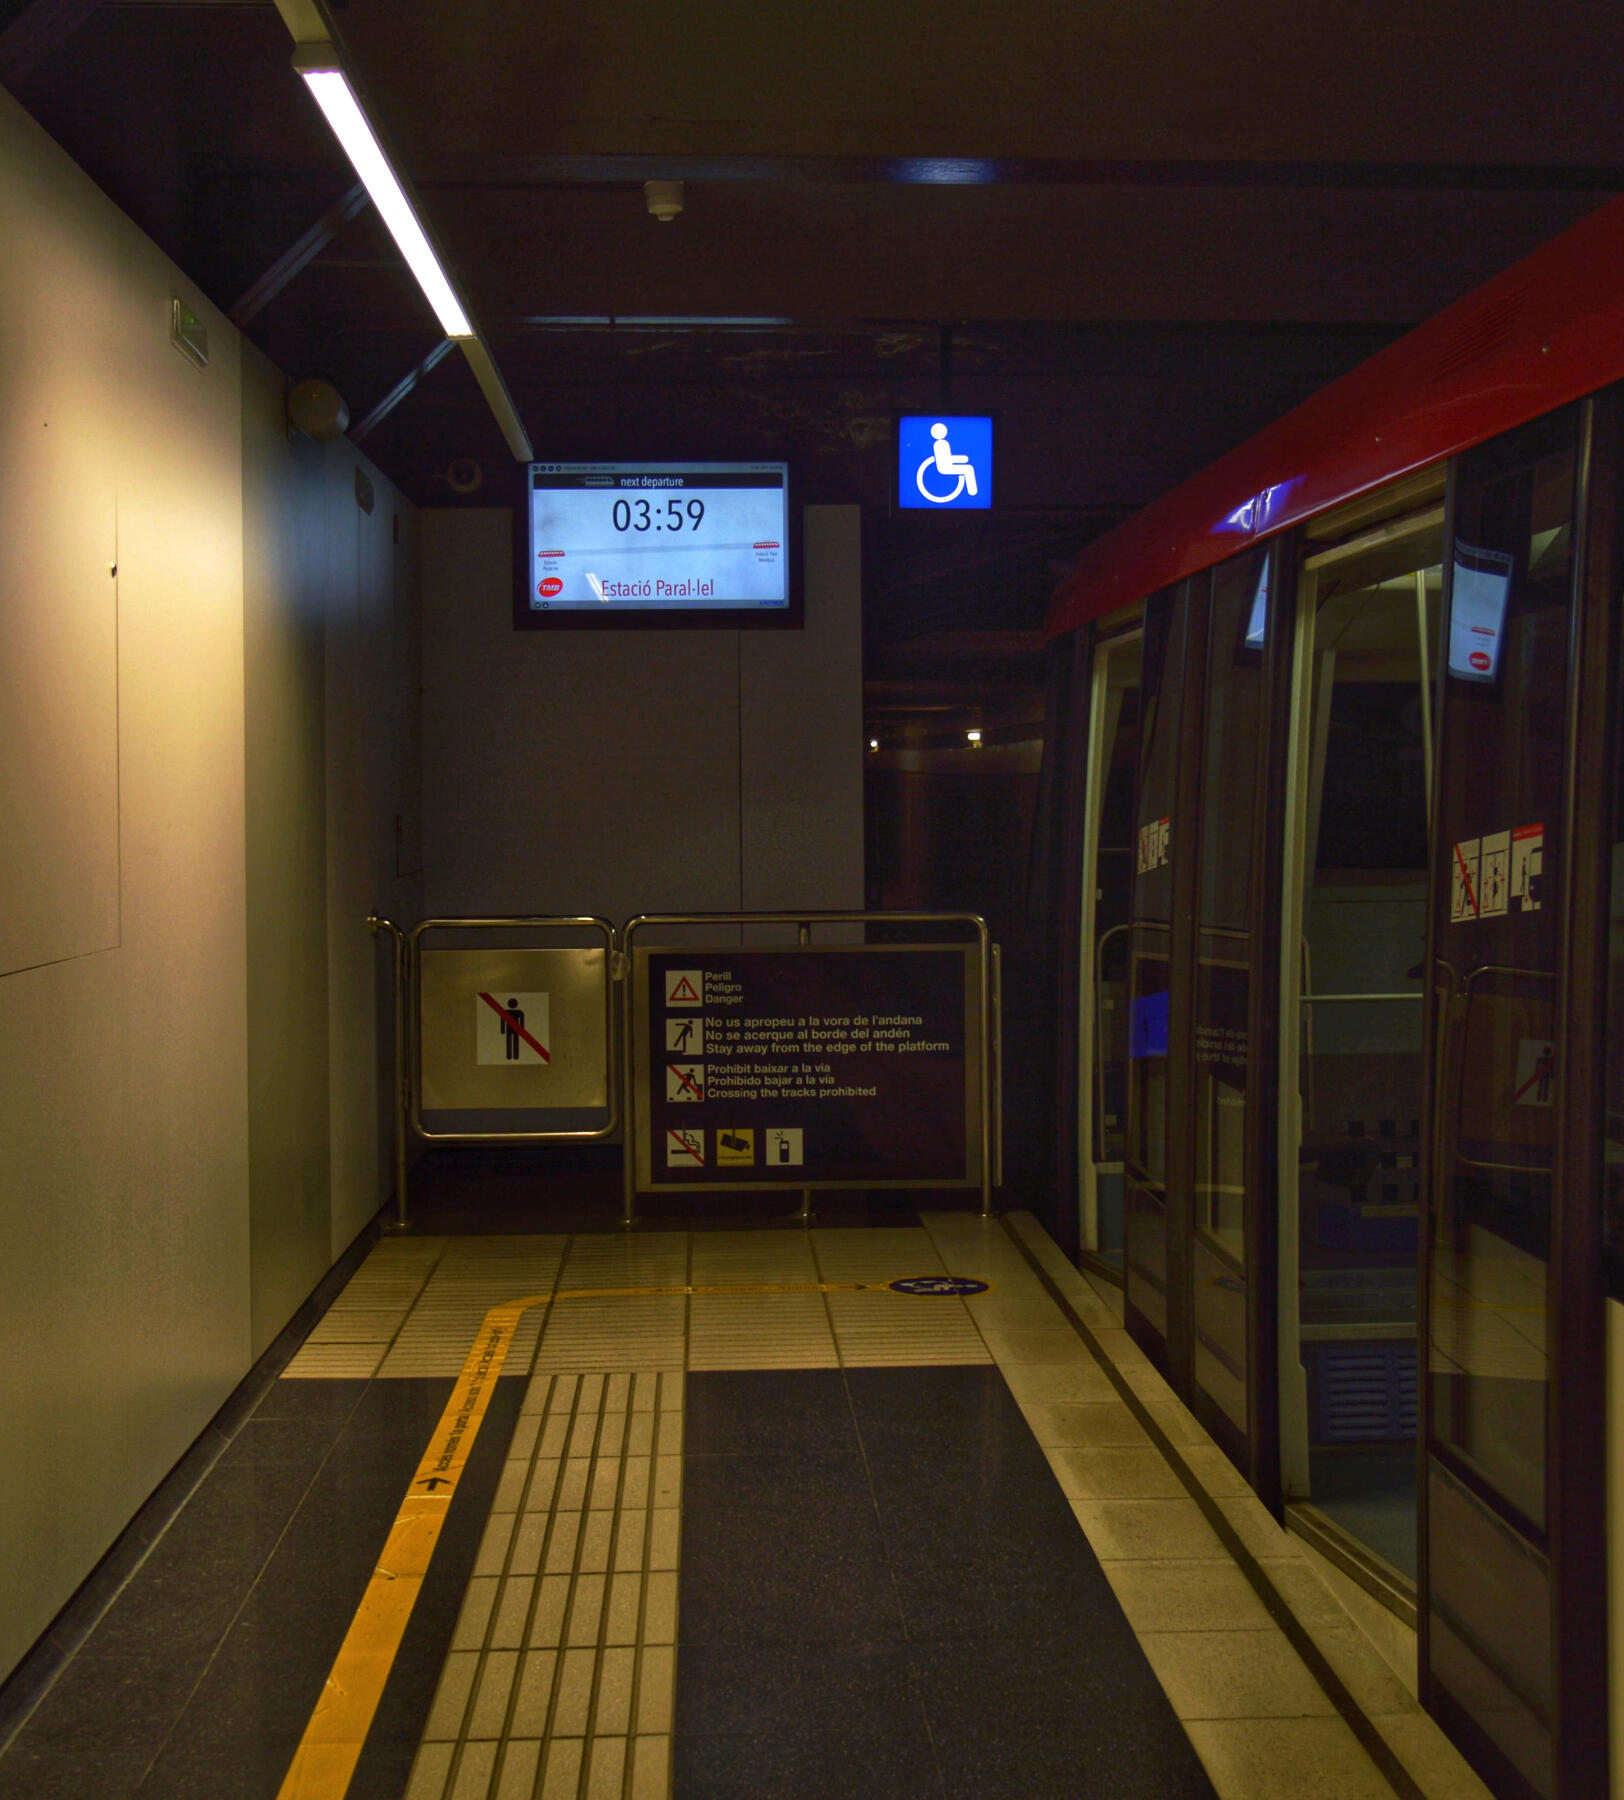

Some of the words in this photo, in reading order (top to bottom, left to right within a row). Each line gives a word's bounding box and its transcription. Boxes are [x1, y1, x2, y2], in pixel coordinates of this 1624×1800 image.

[621, 478, 640, 487] next
[642, 476, 683, 489] departure
[613, 499, 705, 532] 03:59
[602, 580, 651, 596] Estació
[705, 972, 731, 981] Perill
[706, 983, 742, 993] Peligro
[706, 995, 743, 1005] Danger
[706, 1018, 722, 1027] No
[727, 1019, 741, 1027] us
[744, 1018, 795, 1029] apropeu
[798, 1018, 805, 1026] a
[809, 1016, 819, 1026] la
[824, 1017, 850, 1025] vora
[854, 1015, 869, 1025] de
[873, 1015, 922, 1025] l'andana
[706, 1030, 722, 1040] No
[727, 1032, 740, 1040] se
[744, 1032, 794, 1041] acerque
[798, 1029, 807, 1039] al
[812, 1029, 847, 1039] borde
[851, 1029, 869, 1038] del
[873, 1028, 910, 1038] andén
[706, 1044, 733, 1055] Stay
[737, 1045, 767, 1055] away
[771, 1042, 799, 1053] from
[804, 1042, 823, 1052] the
[827, 1042, 856, 1054] edge
[860, 1041, 872, 1051] of
[876, 1041, 894, 1051] the
[898, 1041, 949, 1052] platform
[708, 1064, 751, 1074] Prohibit
[754, 1064, 789, 1073] baixar
[792, 1065, 798, 1073] a
[802, 1064, 811, 1072] la
[708, 1077, 761, 1086] Prohibido
[765, 1076, 792, 1087] bajar
[806, 1076, 815, 1084] la
[708, 1089, 757, 1099] Crossing
[761, 1088, 778, 1097] the
[782, 1088, 816, 1097] tracks
[820, 1086, 876, 1098] prohibited
